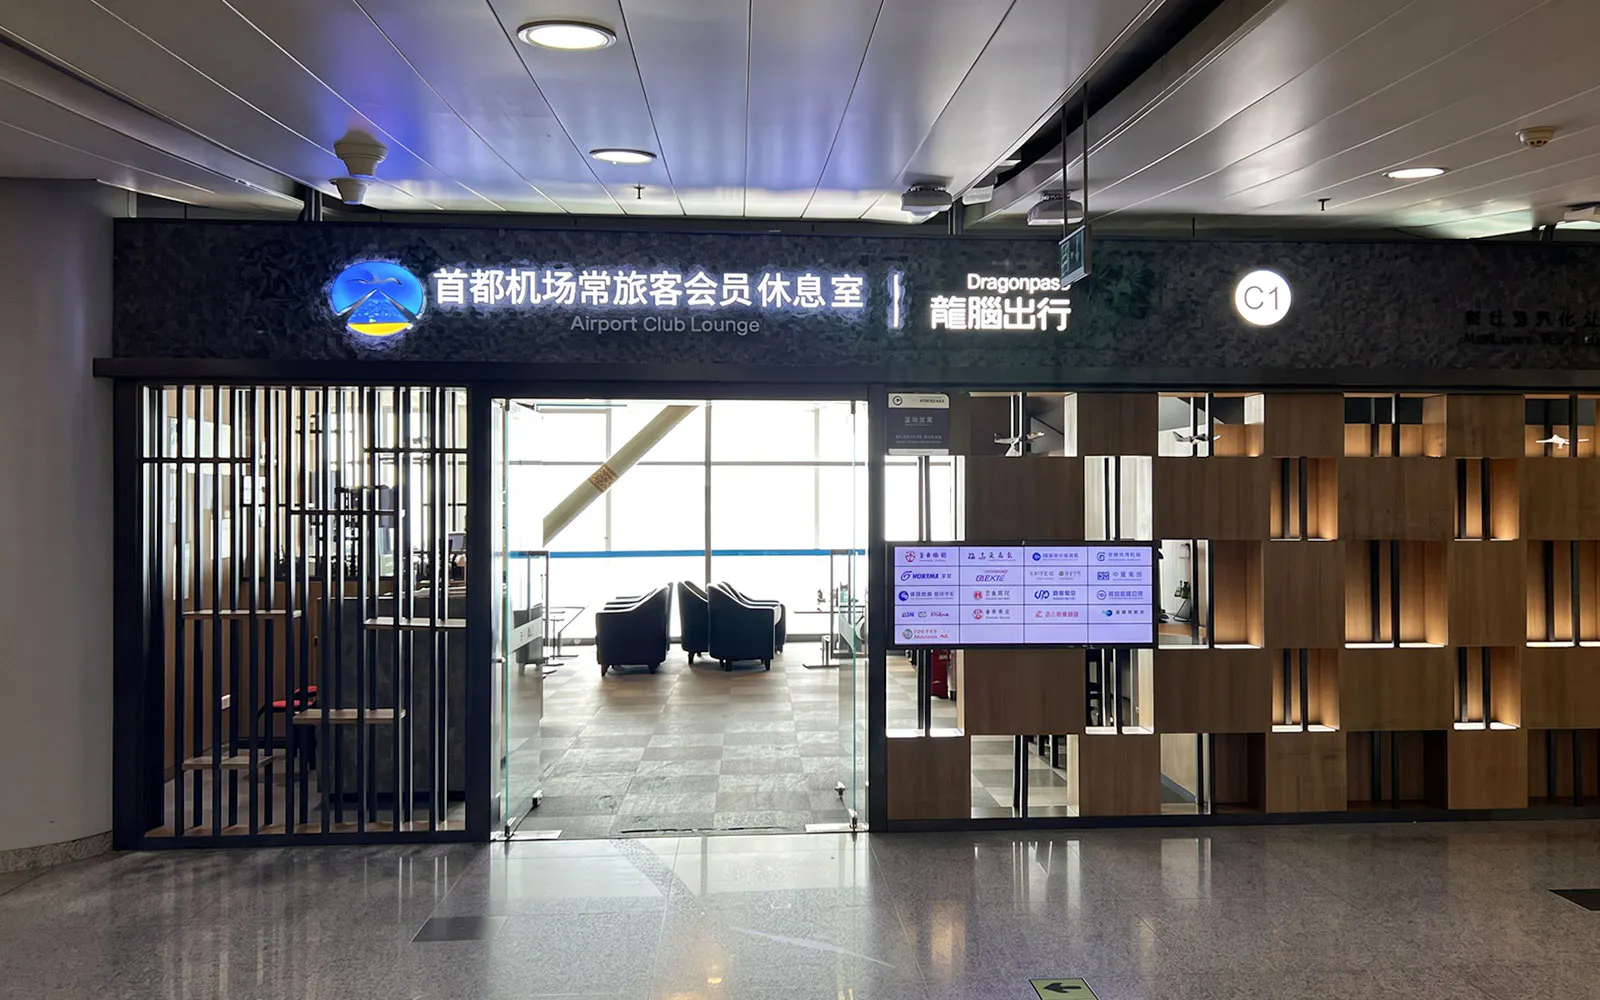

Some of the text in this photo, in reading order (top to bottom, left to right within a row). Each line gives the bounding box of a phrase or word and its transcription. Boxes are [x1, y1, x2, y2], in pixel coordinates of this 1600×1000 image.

[433, 268, 864, 308] 首都机场常旅客会员休息室
[967, 273, 1071, 294] Dragonpas
[1244, 285, 1278, 310] C1
[930, 295, 1071, 331] 龍腦出行
[570, 316, 760, 336] Airport Club Lounge
